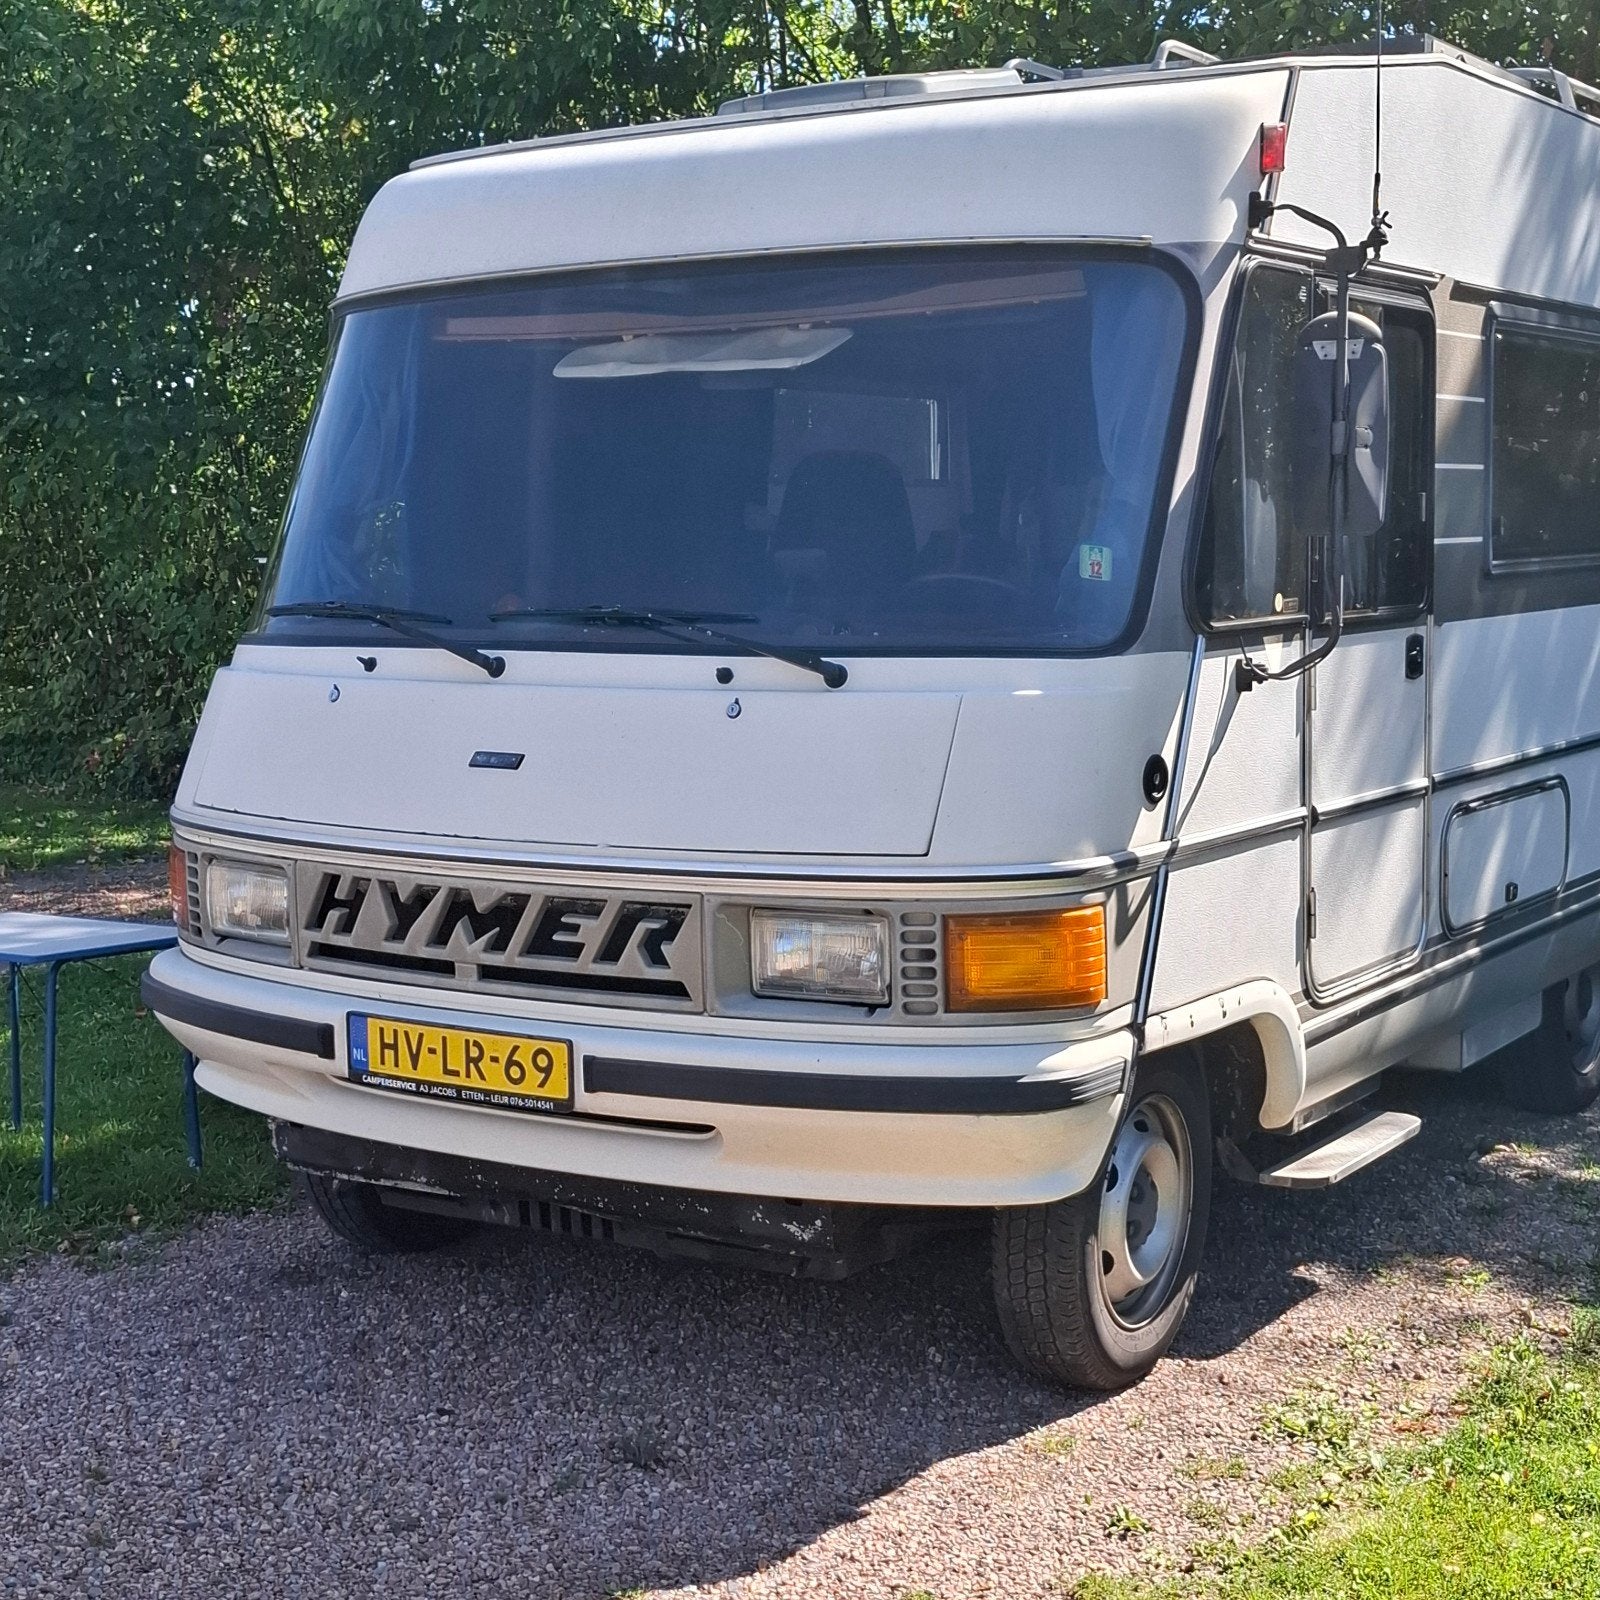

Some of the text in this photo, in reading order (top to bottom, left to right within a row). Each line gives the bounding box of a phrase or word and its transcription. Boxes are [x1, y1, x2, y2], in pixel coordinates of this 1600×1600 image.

[1089, 561, 1102, 575] 12
[306, 872, 693, 969] HYMER
[353, 1048, 367, 1062] NL
[379, 1026, 554, 1088] HV-LR-69
[362, 1075, 416, 1091] CAMPERSERVICE
[430, 1086, 457, 1097] JACOBS
[462, 1090, 484, 1101] ETTEN
[490, 1094, 509, 1105] LEUR
[510, 1096, 554, 1111] 076-5014541
